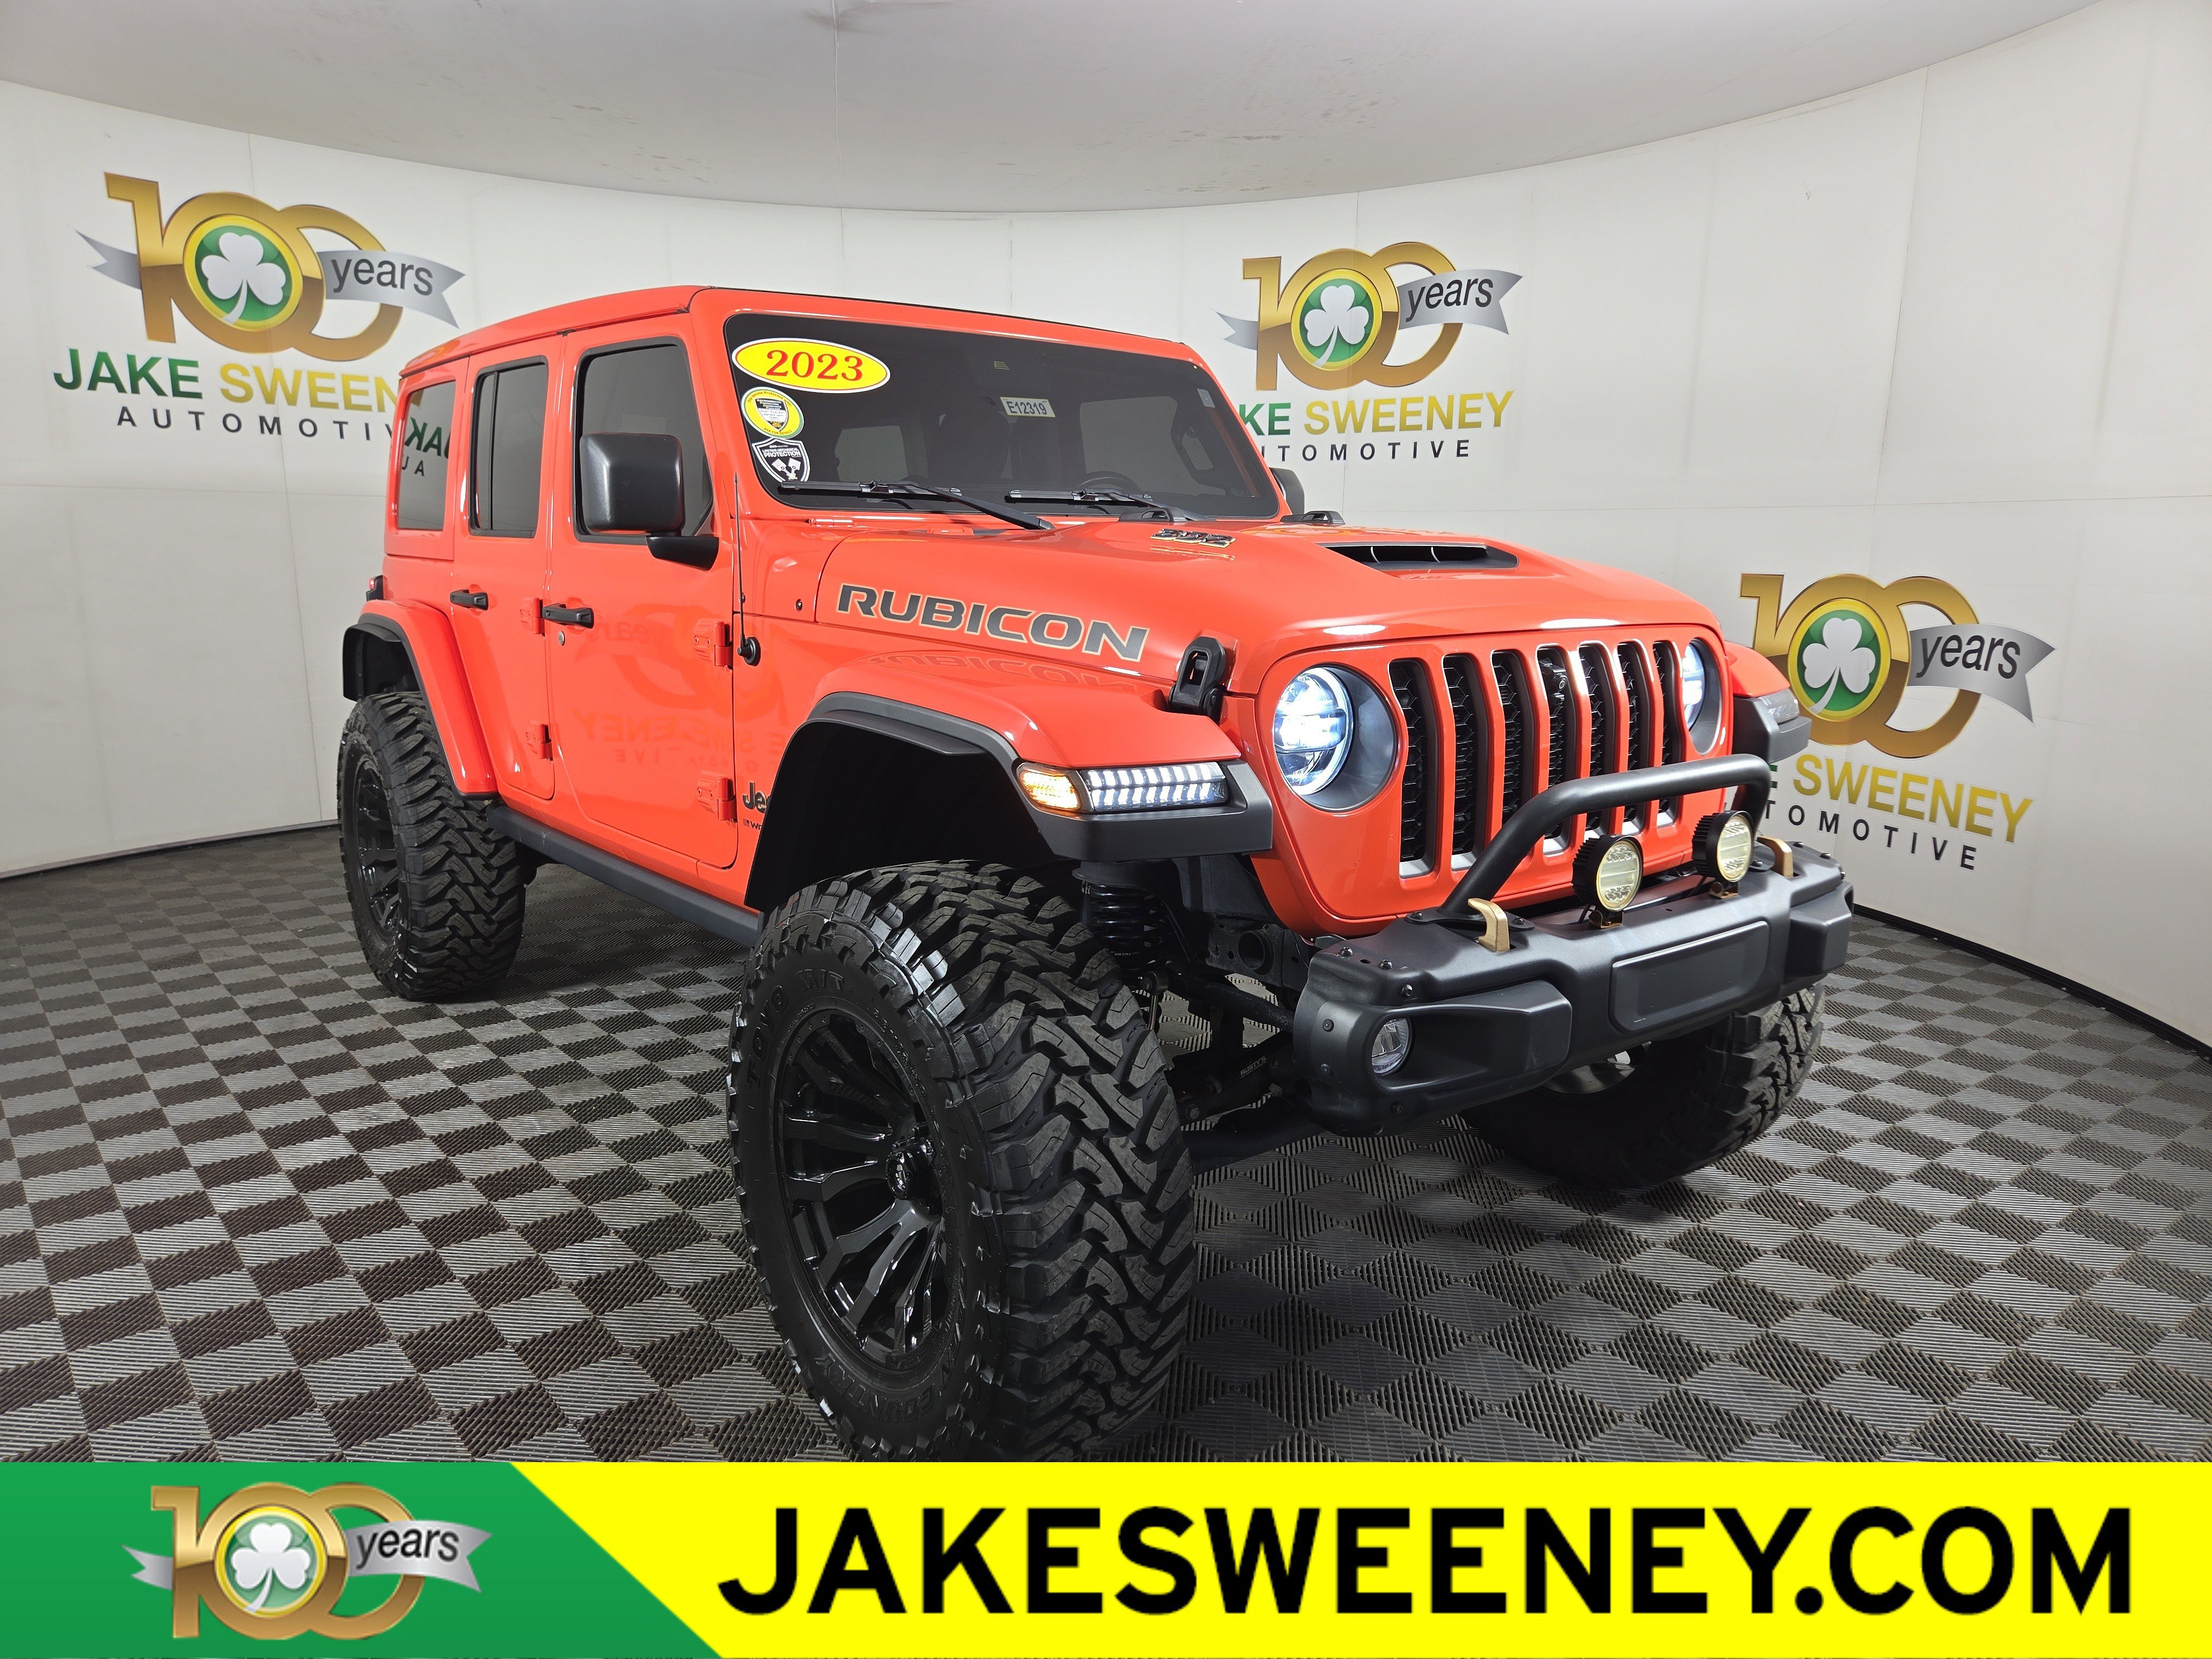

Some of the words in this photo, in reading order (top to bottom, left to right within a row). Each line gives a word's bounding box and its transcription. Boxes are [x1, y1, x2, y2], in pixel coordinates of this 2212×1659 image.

[104, 172, 403, 362] 100
[331, 256, 433, 296] years
[1243, 241, 1464, 391] 100
[1405, 277, 1494, 323] years
[53, 348, 203, 400] JAKE
[220, 363, 399, 413] SWEEN
[766, 350, 863, 382] 2023
[118, 407, 392, 440] AUTOMOTI
[1006, 401, 1047, 415] E12319
[1238, 402, 1291, 436] KE
[1304, 391, 1514, 435] SWEENEY
[1262, 439, 1469, 461] TOMOTIVE
[835, 582, 1150, 663] RUBICON
[1916, 634, 2021, 679] years
[742, 781, 768, 814] Je
[1793, 754, 2033, 844] SWEENEY
[1766, 800, 1977, 871] TOMOTIVE
